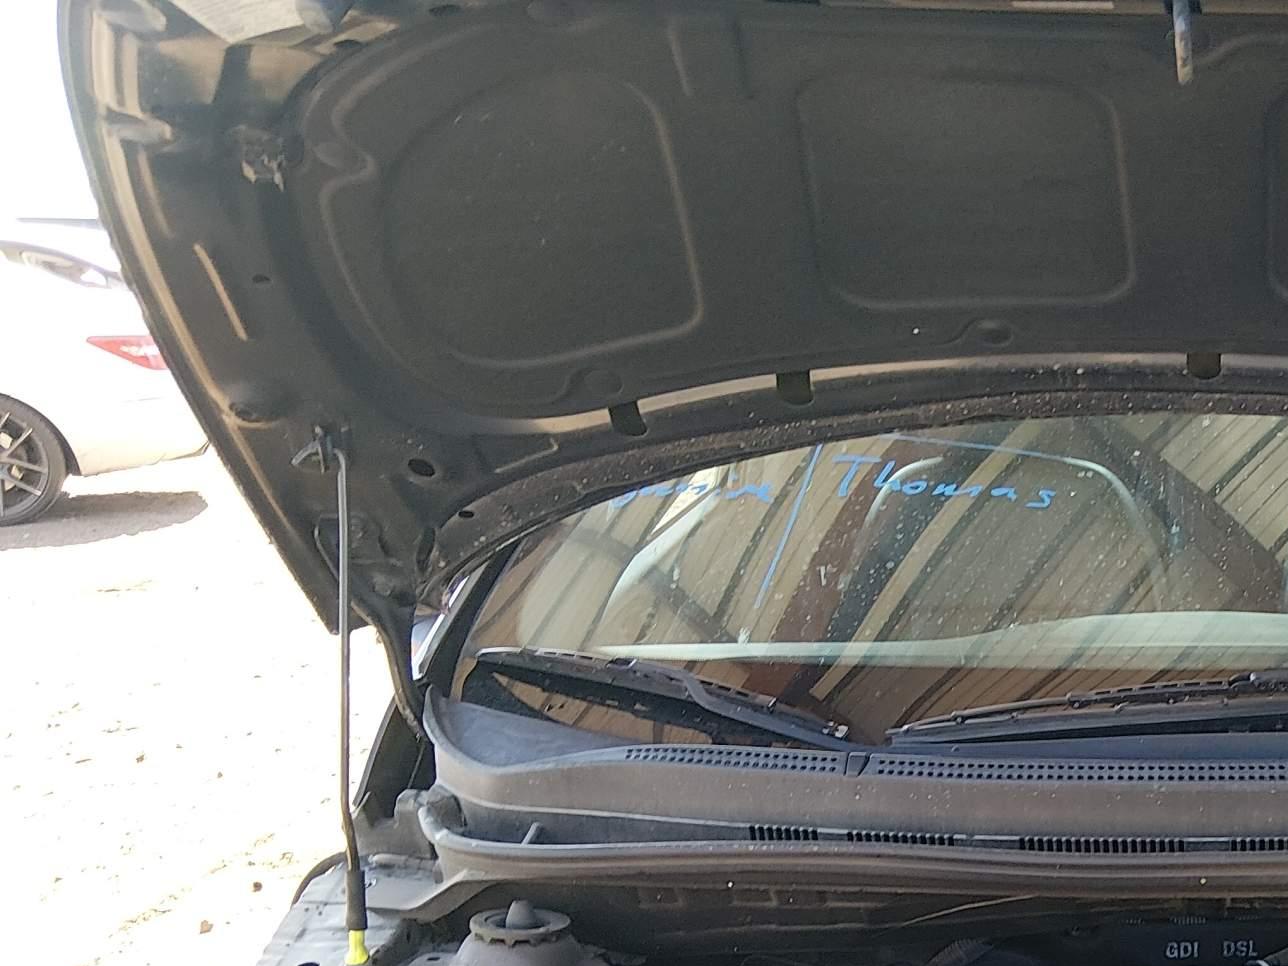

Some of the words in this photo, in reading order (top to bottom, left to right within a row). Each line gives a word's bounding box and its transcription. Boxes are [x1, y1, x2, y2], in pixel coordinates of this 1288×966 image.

[833, 454, 1057, 510] Thomas
[1165, 941, 1200, 959] GDI
[1222, 939, 1259, 958] DSL
